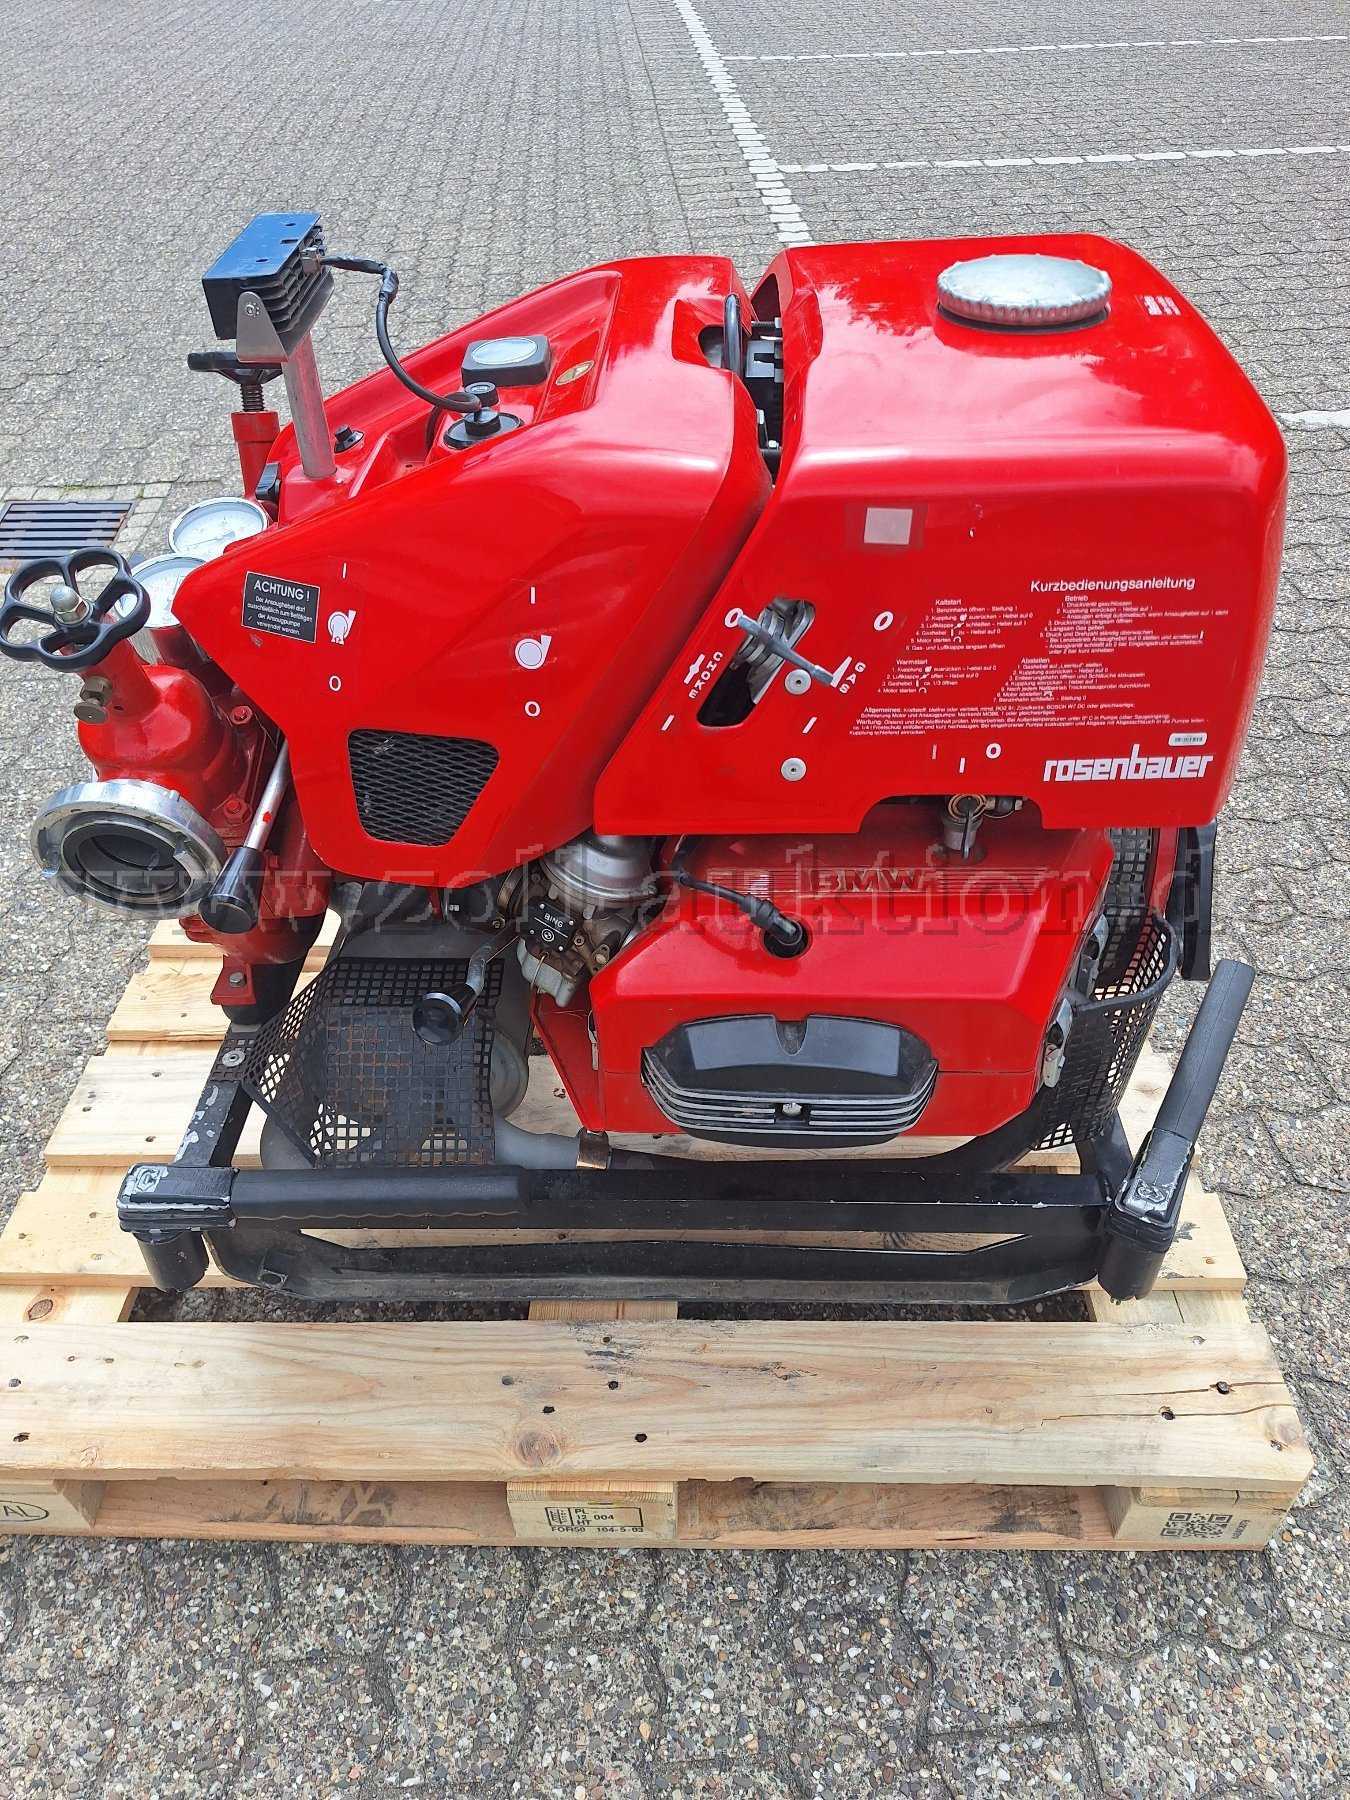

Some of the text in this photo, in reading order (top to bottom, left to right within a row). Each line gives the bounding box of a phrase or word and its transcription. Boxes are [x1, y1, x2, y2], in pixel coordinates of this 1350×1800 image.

[254, 580, 304, 600] ACHTUNG
[1030, 577, 1195, 592] Kurzbedienungsanleitung
[688, 651, 723, 699] CHOKE
[839, 662, 866, 694] GAS
[1043, 744, 1214, 782] rosenbauer
[809, 868, 924, 892] BMW
[543, 912, 564, 928] BING
